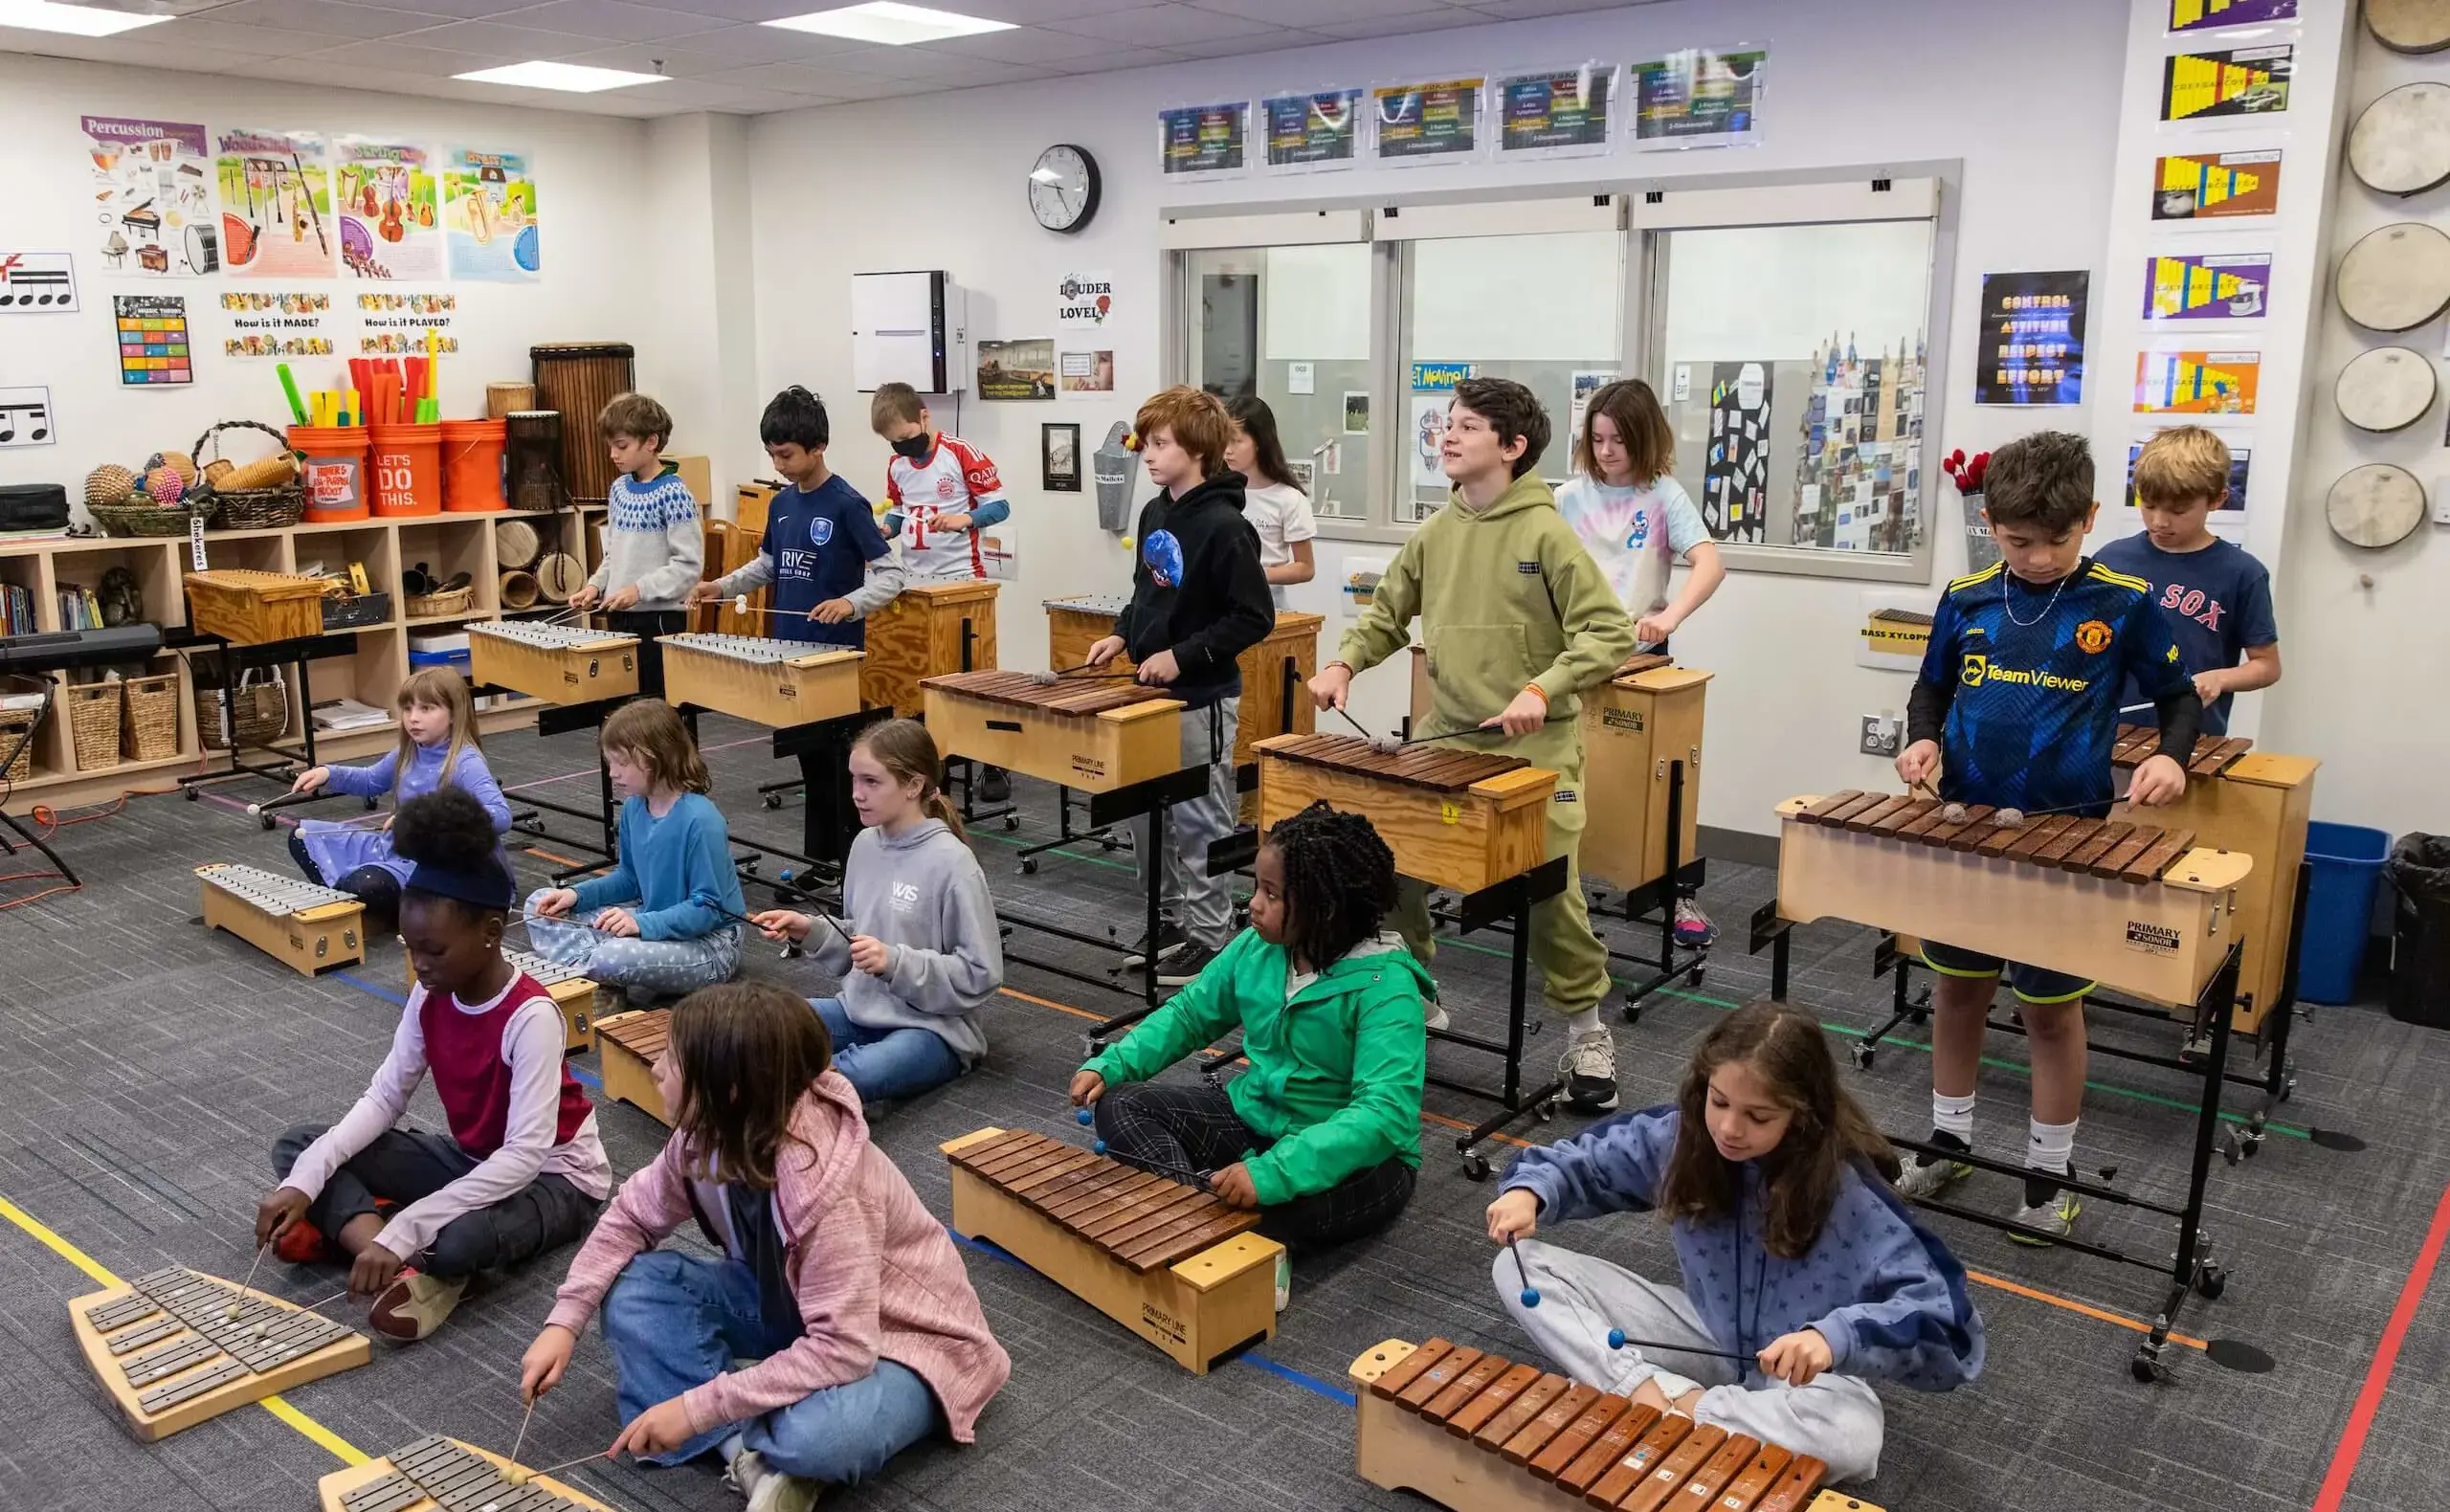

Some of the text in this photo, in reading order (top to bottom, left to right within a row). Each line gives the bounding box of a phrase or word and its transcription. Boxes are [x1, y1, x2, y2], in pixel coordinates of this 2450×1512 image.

[86, 119, 165, 140] Percussion
[1059, 282, 1111, 296] LUDER
[2001, 295, 2070, 309] CONTROL
[1059, 307, 1101, 320] LOVEL
[234, 318, 320, 328] How is it MADE?
[365, 318, 451, 327] How is it PLAYED?
[2000, 320, 2068, 333] ATTITUDE
[1998, 344, 2067, 358] RESPECT
[1996, 368, 2065, 385] EFFORT
[376, 455, 412, 467] LET'S
[378, 467, 412, 491] DO
[380, 492, 418, 506] THIS.
[191, 519, 205, 567] Shekeres
[2159, 583, 2227, 633] SOX
[1860, 629, 1930, 641] BASS XYLOPH
[1987, 664, 2089, 693] TeamViewer
[1603, 707, 1644, 722] PRIMARY
[1614, 718, 1638, 729] SONOR
[1094, 760, 1105, 769] LINE
[2127, 921, 2181, 939] PRIMARY
[2141, 934, 2172, 947] SONOR
[1143, 1301, 1171, 1325] PRIMARY
[1171, 1319, 1187, 1336] LINE
